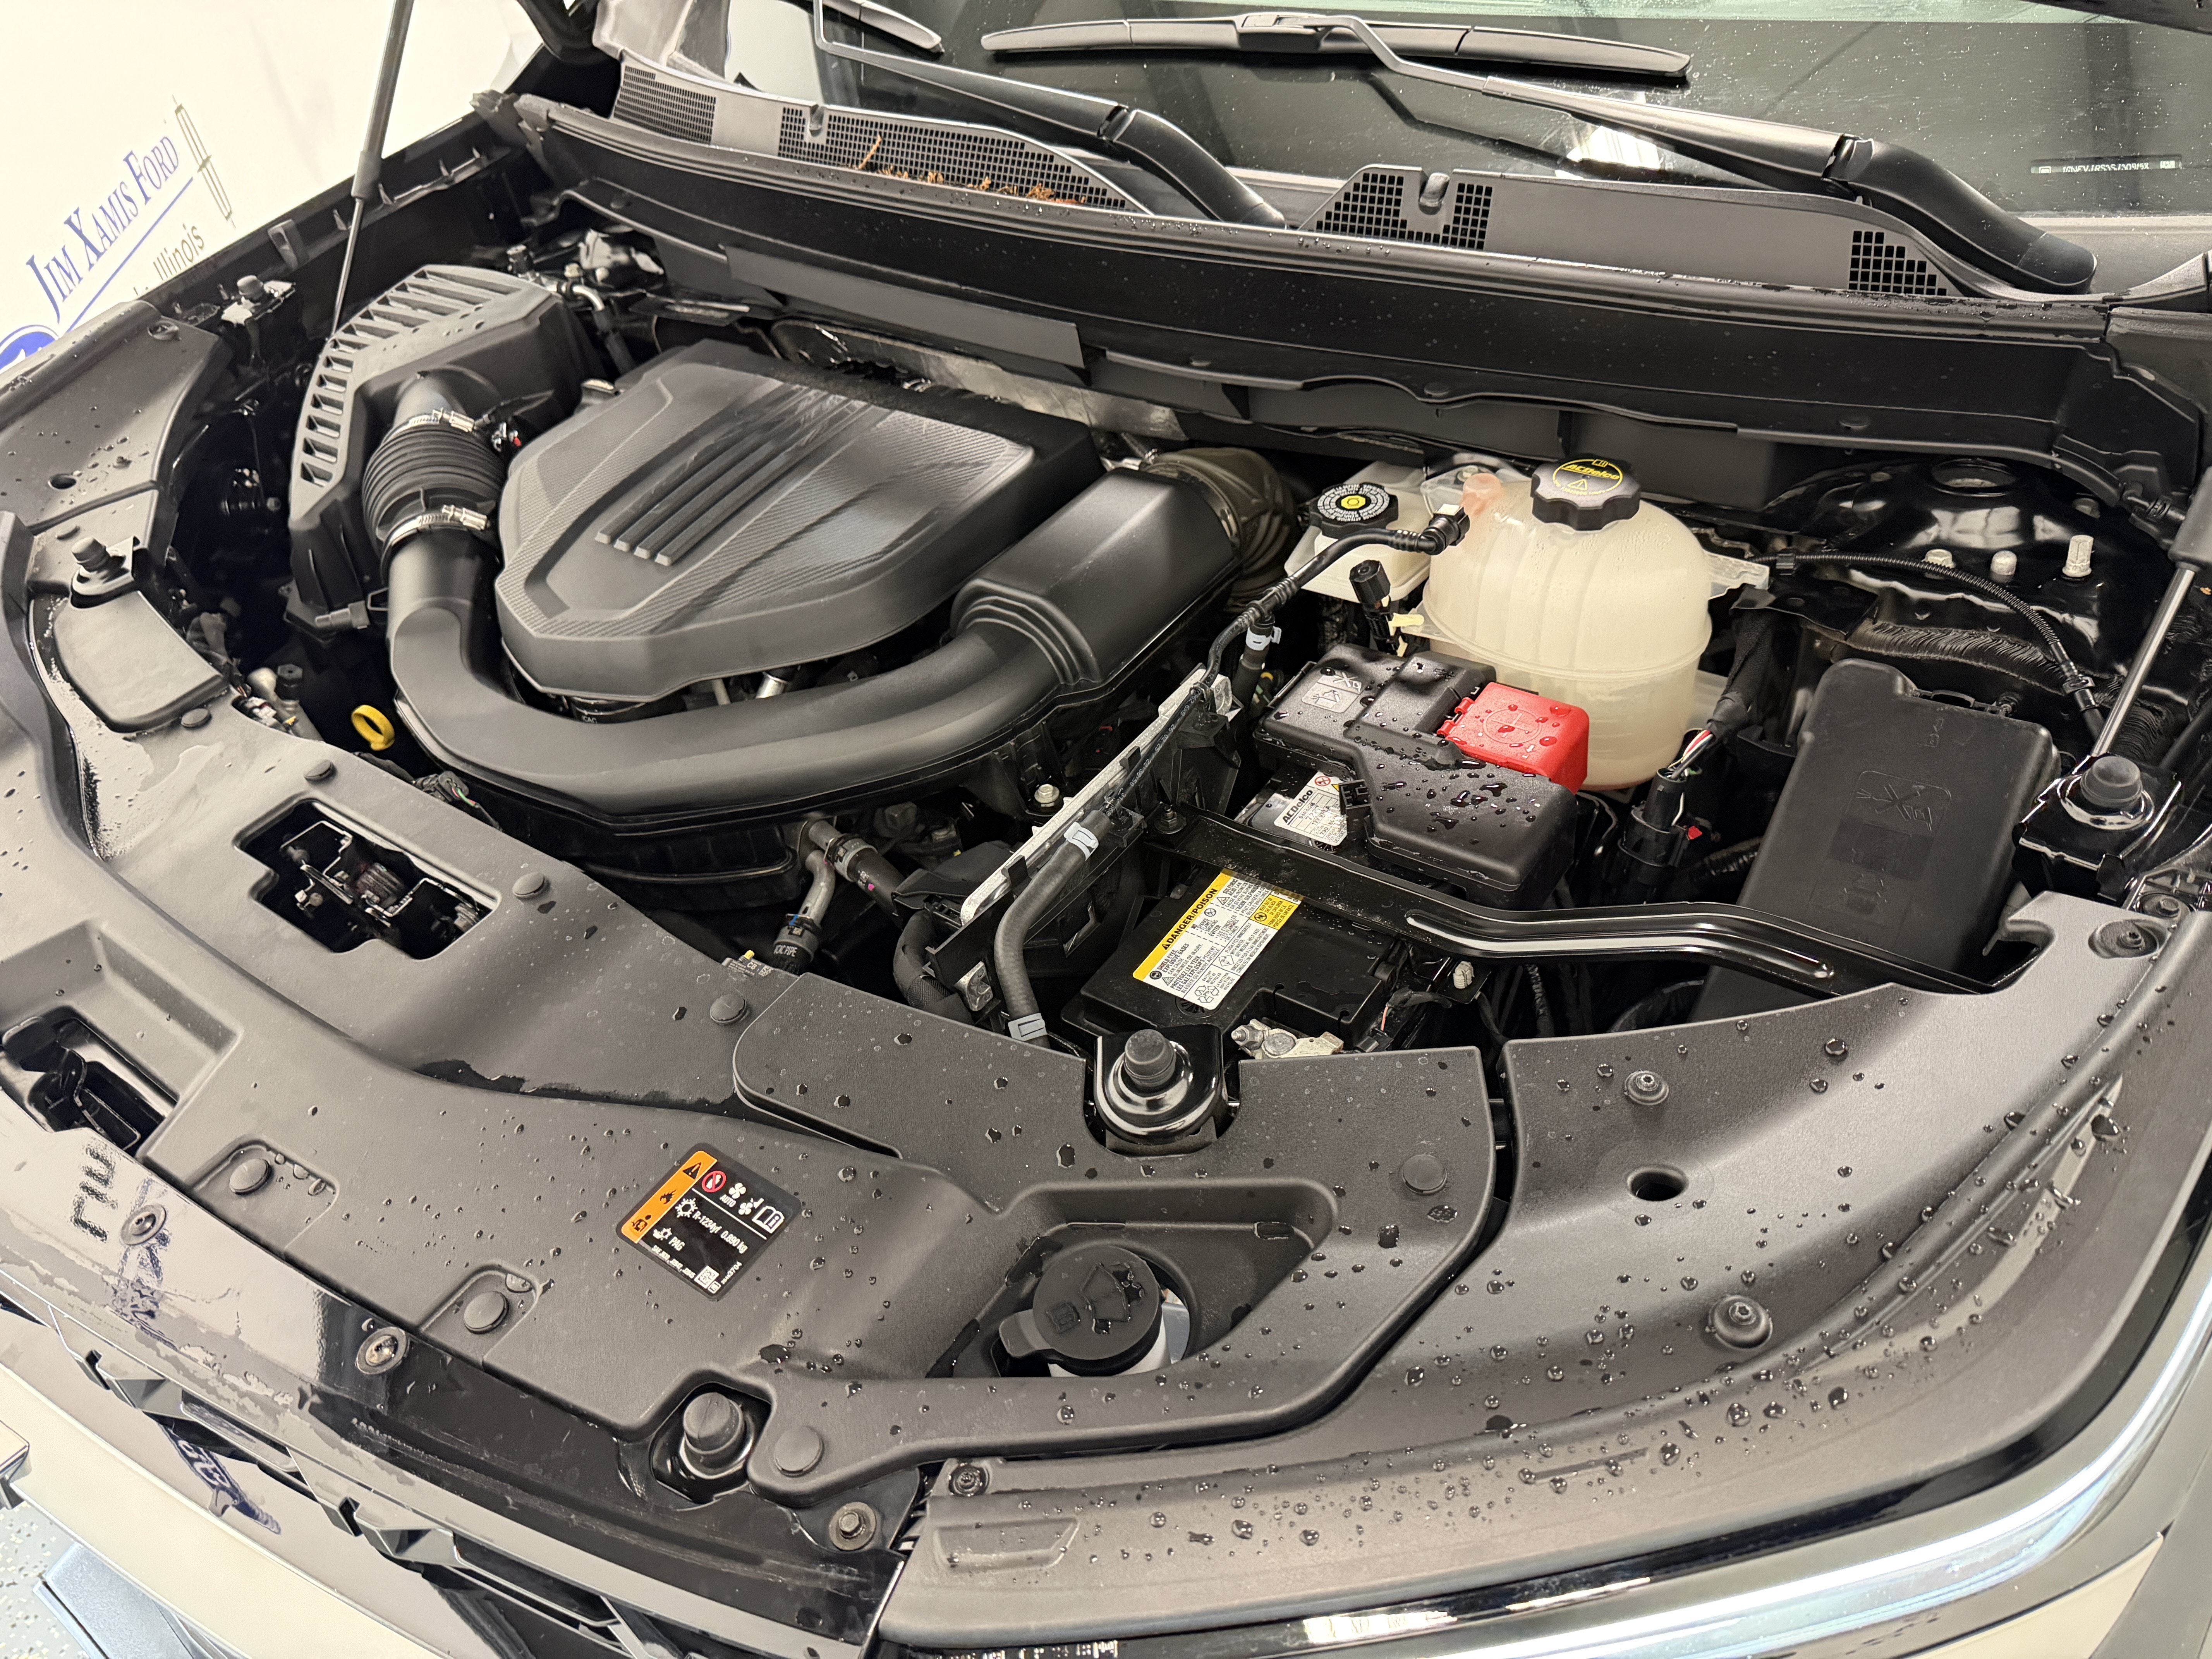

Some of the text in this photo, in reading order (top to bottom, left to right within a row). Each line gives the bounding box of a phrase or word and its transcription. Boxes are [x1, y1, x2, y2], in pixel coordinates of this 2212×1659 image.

[26, 136, 180, 325] JIM XAMIS FORD
[153, 222, 205, 281] Illinois
[1565, 464, 1620, 480] ACDelco
[1283, 790, 1312, 823] ACDelco
[1166, 888, 1217, 943] DANGER/POISON
[1208, 925, 1221, 936] ÉVITER
[1157, 958, 1170, 970] SHIELD
[1162, 943, 1189, 972] EXPLOSIVE GASES
[1173, 957, 1184, 968] CAUSE
[1187, 959, 1204, 977] EXPLOSIFS
[1202, 945, 1216, 960] PEUVENT
[720, 1194, 736, 1207] AUTO
[668, 1237, 685, 1250] PAG
[692, 1211, 747, 1254] R-1234yf 0.890 kg
